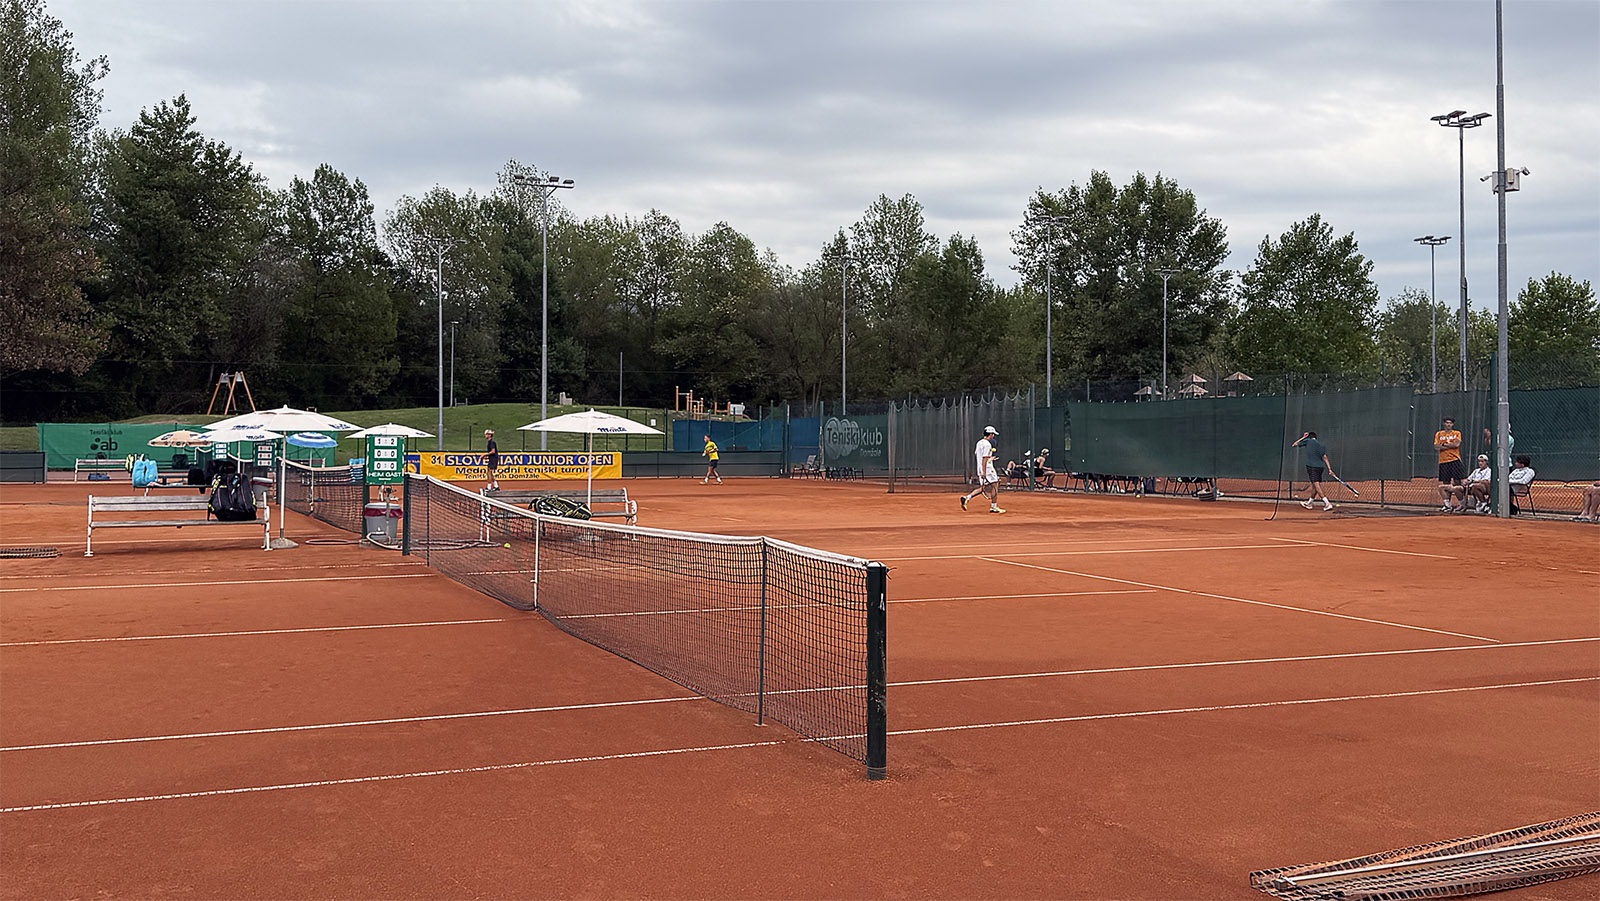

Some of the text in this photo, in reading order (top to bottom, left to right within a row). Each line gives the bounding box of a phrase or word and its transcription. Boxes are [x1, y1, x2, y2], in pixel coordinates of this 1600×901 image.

[827, 427, 883, 446] Teniški klub
[527, 455, 574, 465] JUNIOR
[577, 455, 612, 465] OPEN
[524, 466, 557, 474] teniški
